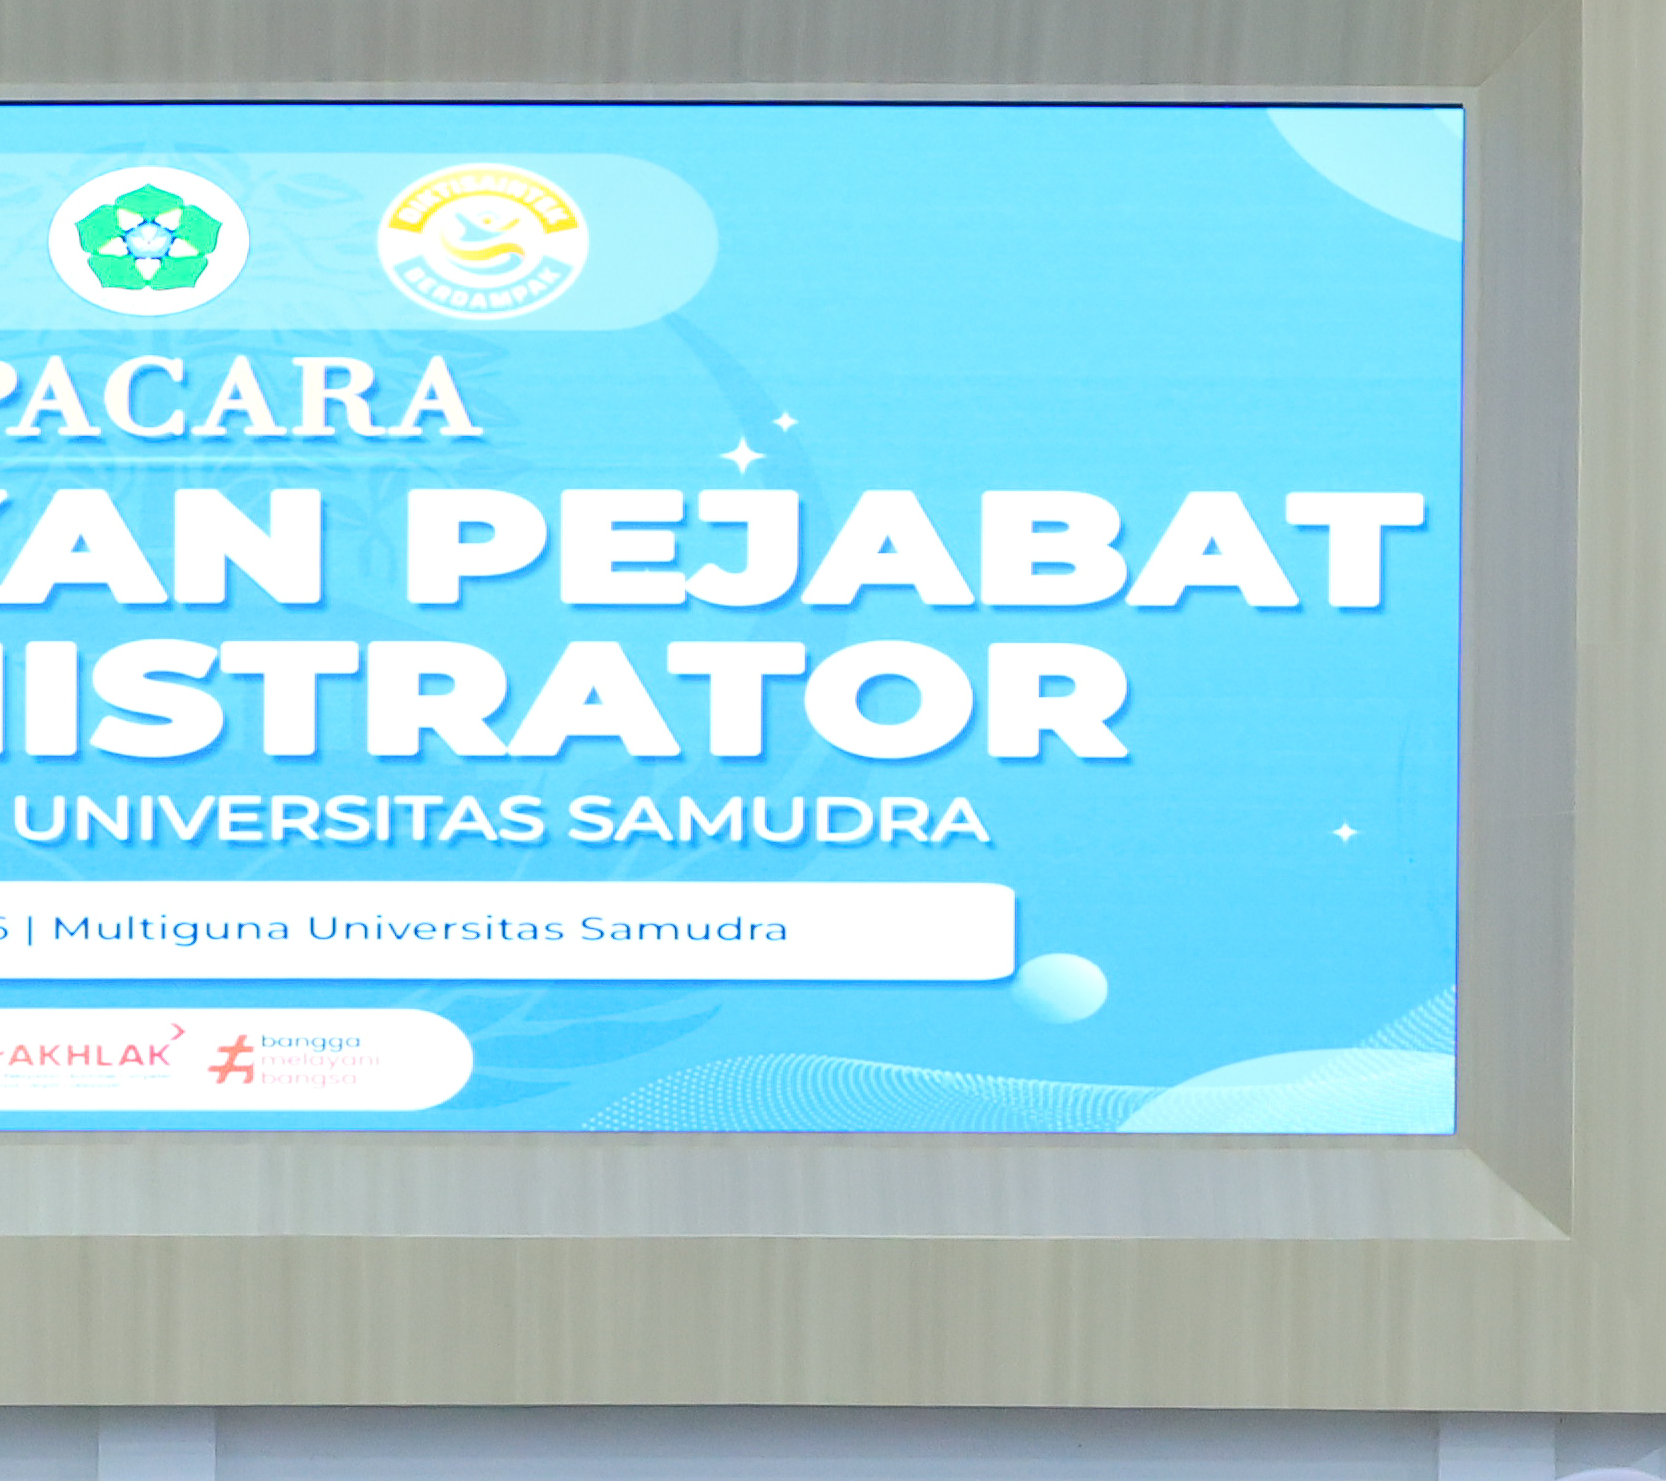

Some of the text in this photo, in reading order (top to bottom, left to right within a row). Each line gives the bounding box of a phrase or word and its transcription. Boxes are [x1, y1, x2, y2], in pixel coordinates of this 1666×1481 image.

[403, 266, 562, 309] BERDAMPAK
[408, 487, 1424, 608] PEJABAT
[13, 794, 545, 842] UNIVERSITAS
[569, 795, 990, 842] SAMUDRA
[54, 914, 290, 948] Multiguna
[308, 914, 564, 941] Universitas
[580, 914, 788, 941] Samudra
[261, 1035, 361, 1052] bangga
[261, 1053, 380, 1070] melayani
[261, 1071, 357, 1089] bangsa
